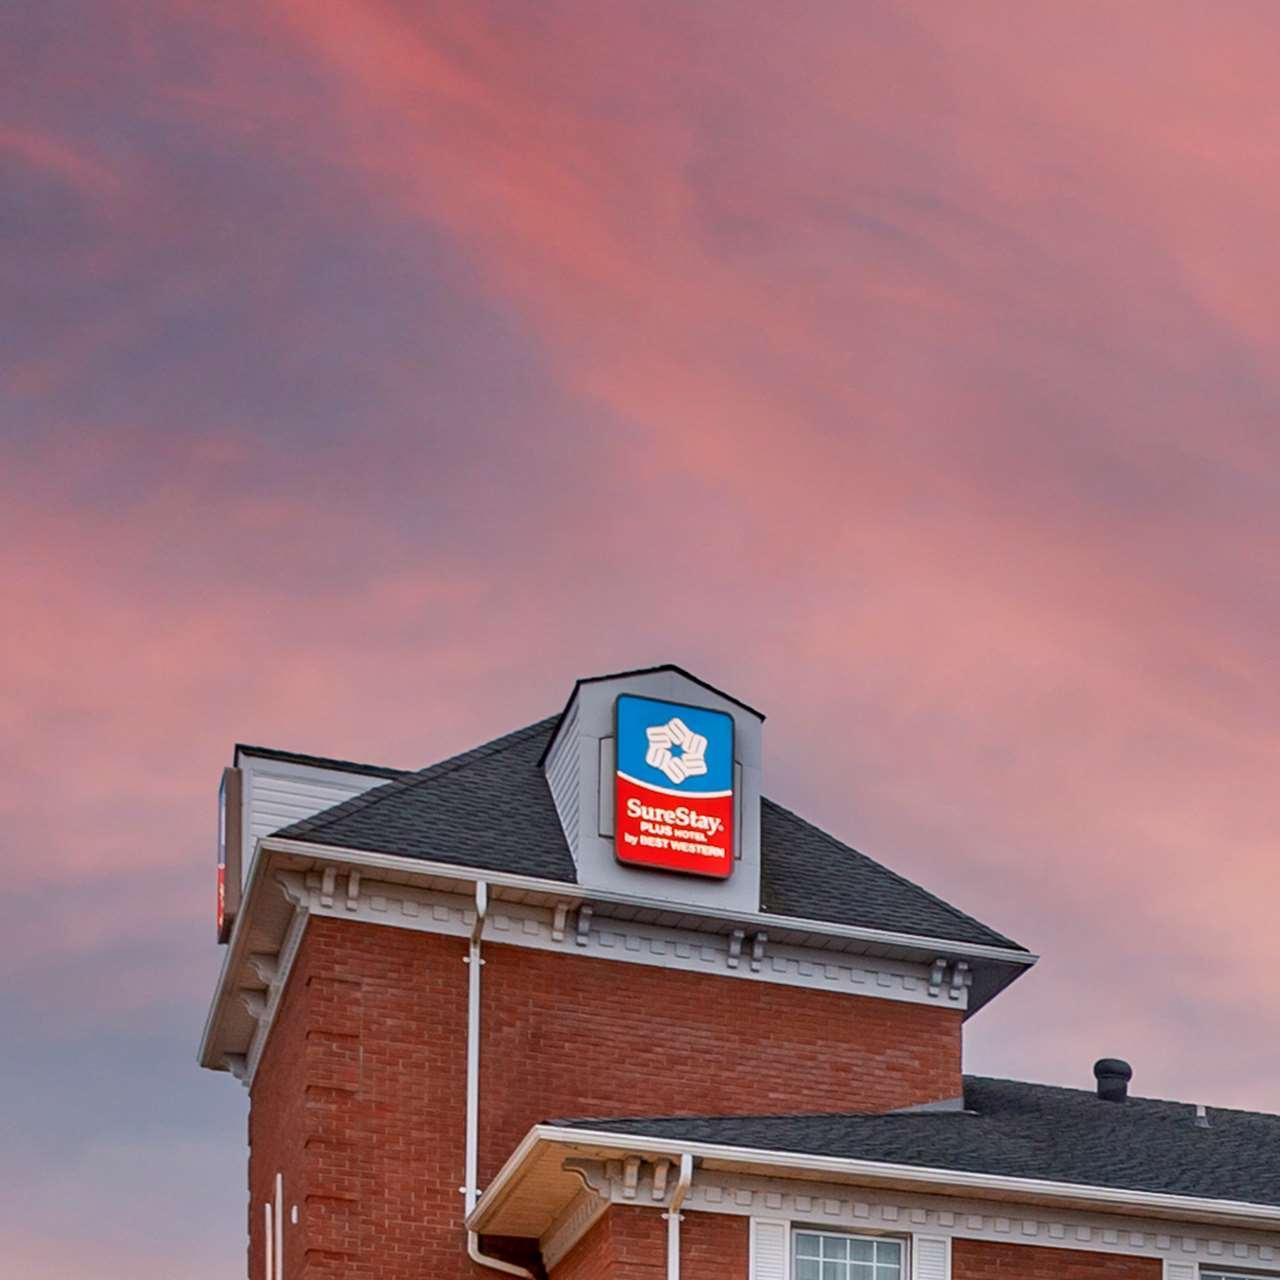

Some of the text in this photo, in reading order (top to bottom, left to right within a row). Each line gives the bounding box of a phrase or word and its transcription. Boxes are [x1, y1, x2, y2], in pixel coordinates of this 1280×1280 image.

[627, 798, 721, 836] SureStay
[640, 821, 708, 842] PLUS HOTEL
[624, 832, 726, 858] by BEST WESTERN
